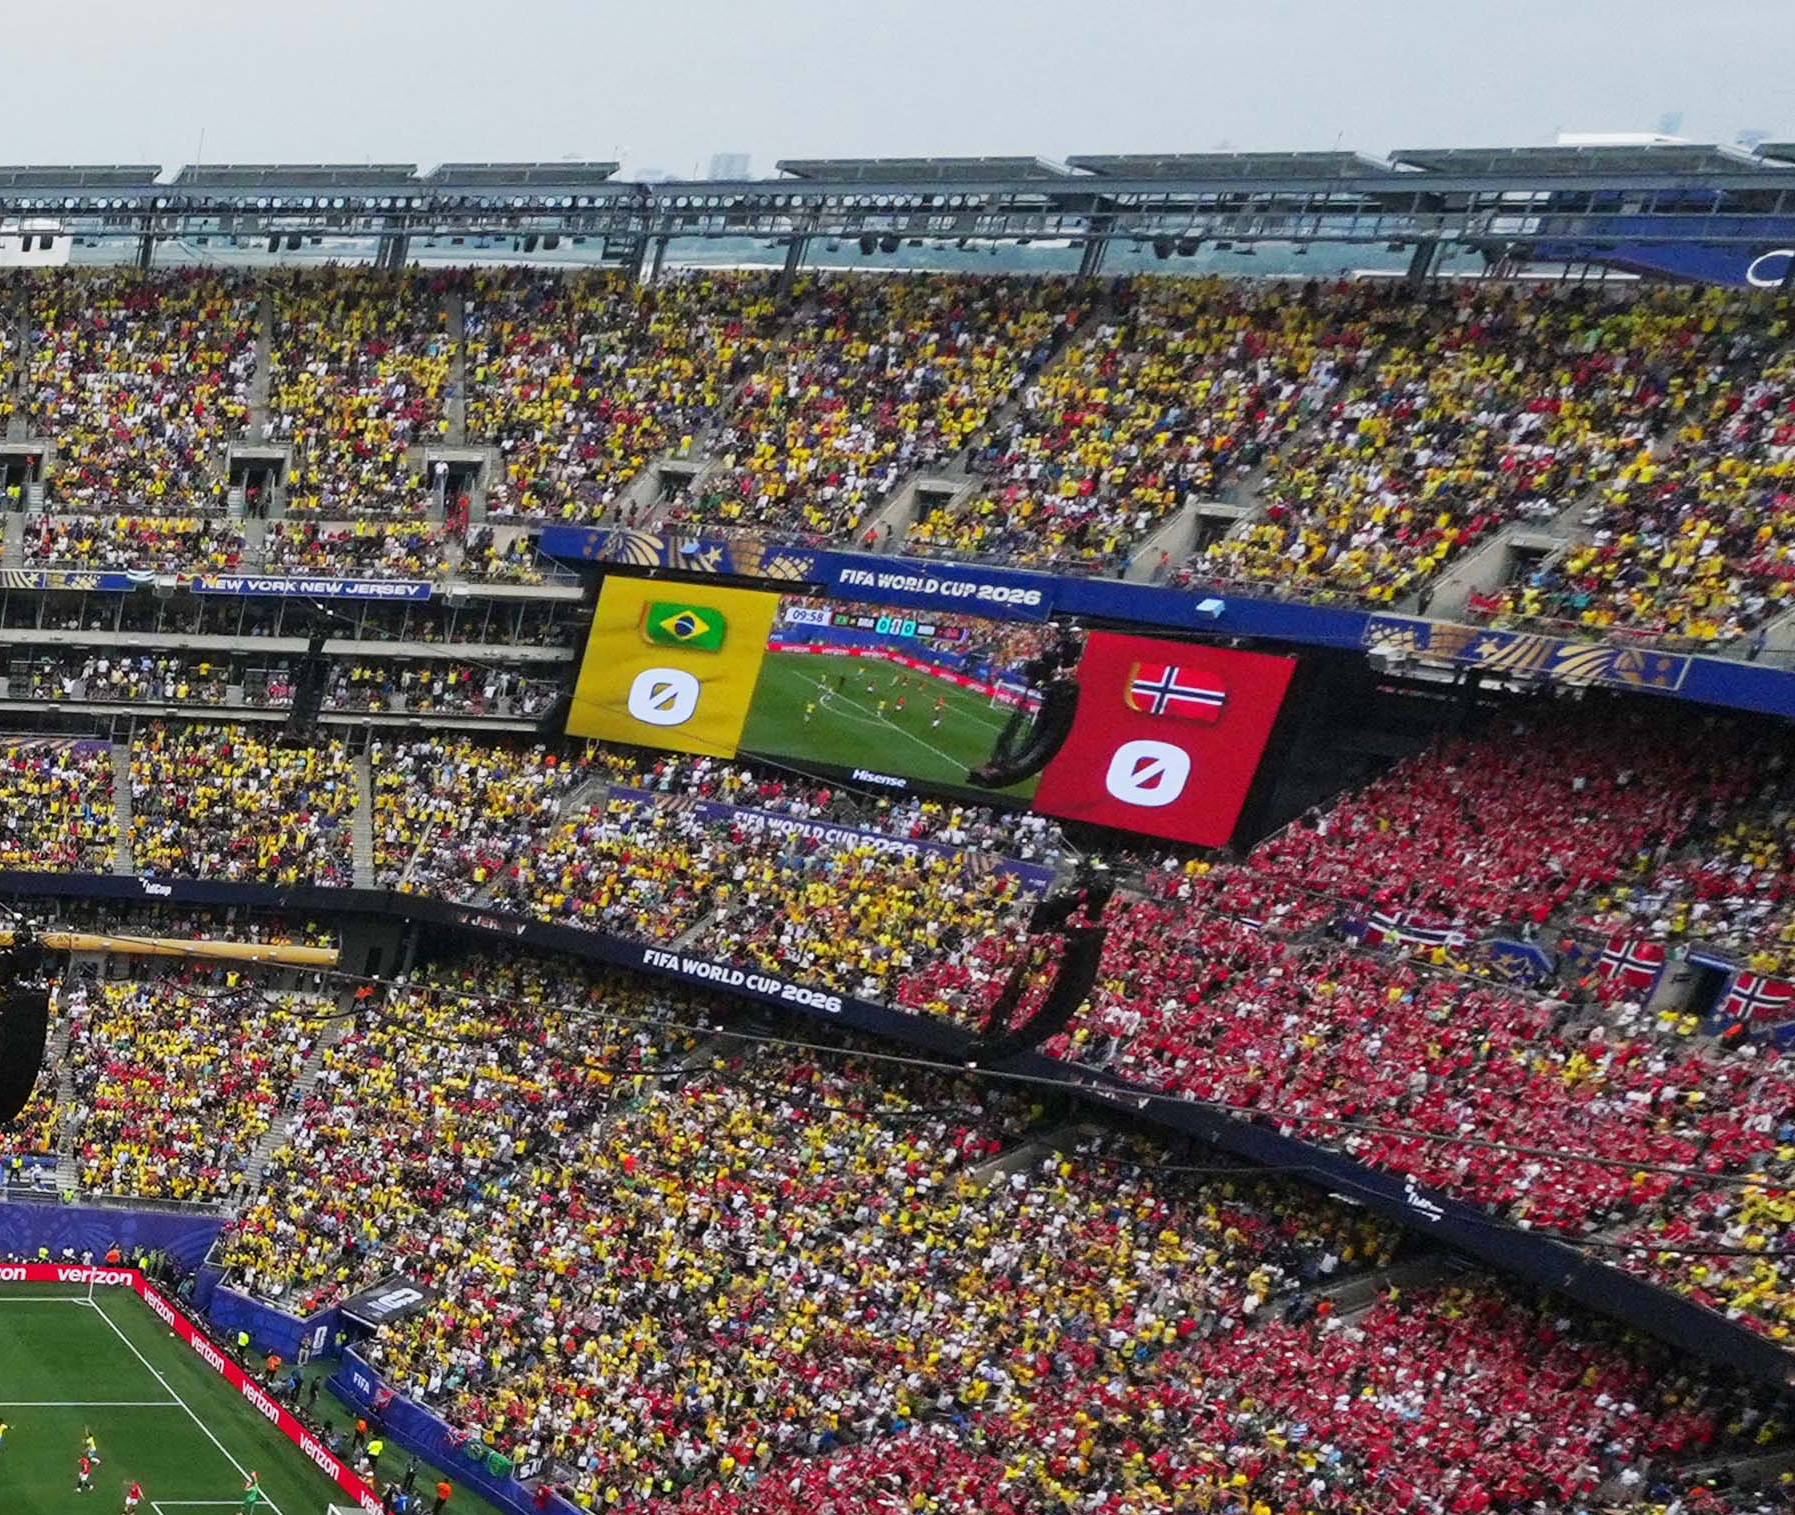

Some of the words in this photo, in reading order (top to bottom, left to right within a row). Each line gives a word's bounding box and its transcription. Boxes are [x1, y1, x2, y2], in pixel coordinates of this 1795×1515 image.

[246, 579, 297, 592] YORK
[300, 581, 343, 594] NEW
[345, 582, 420, 596] JERSEY
[839, 569, 875, 587] FIFA
[877, 573, 938, 595] WORLD
[940, 581, 977, 599] CUP
[977, 584, 1042, 606] 2026
[792, 610, 824, 623] 09:58
[852, 769, 907, 788] Hisense
[825, 828, 858, 848] CUP
[642, 949, 679, 972] FIFA
[680, 955, 744, 985] WORLD
[745, 972, 782, 995] CUP
[781, 983, 843, 1013] 2026
[57, 1266, 133, 1286] verizon
[143, 1287, 175, 1327] verizon
[191, 1331, 224, 1374] verizon
[353, 1371, 371, 1395] FIFA
[242, 1379, 280, 1424] verizon
[299, 1432, 340, 1480] verizon
